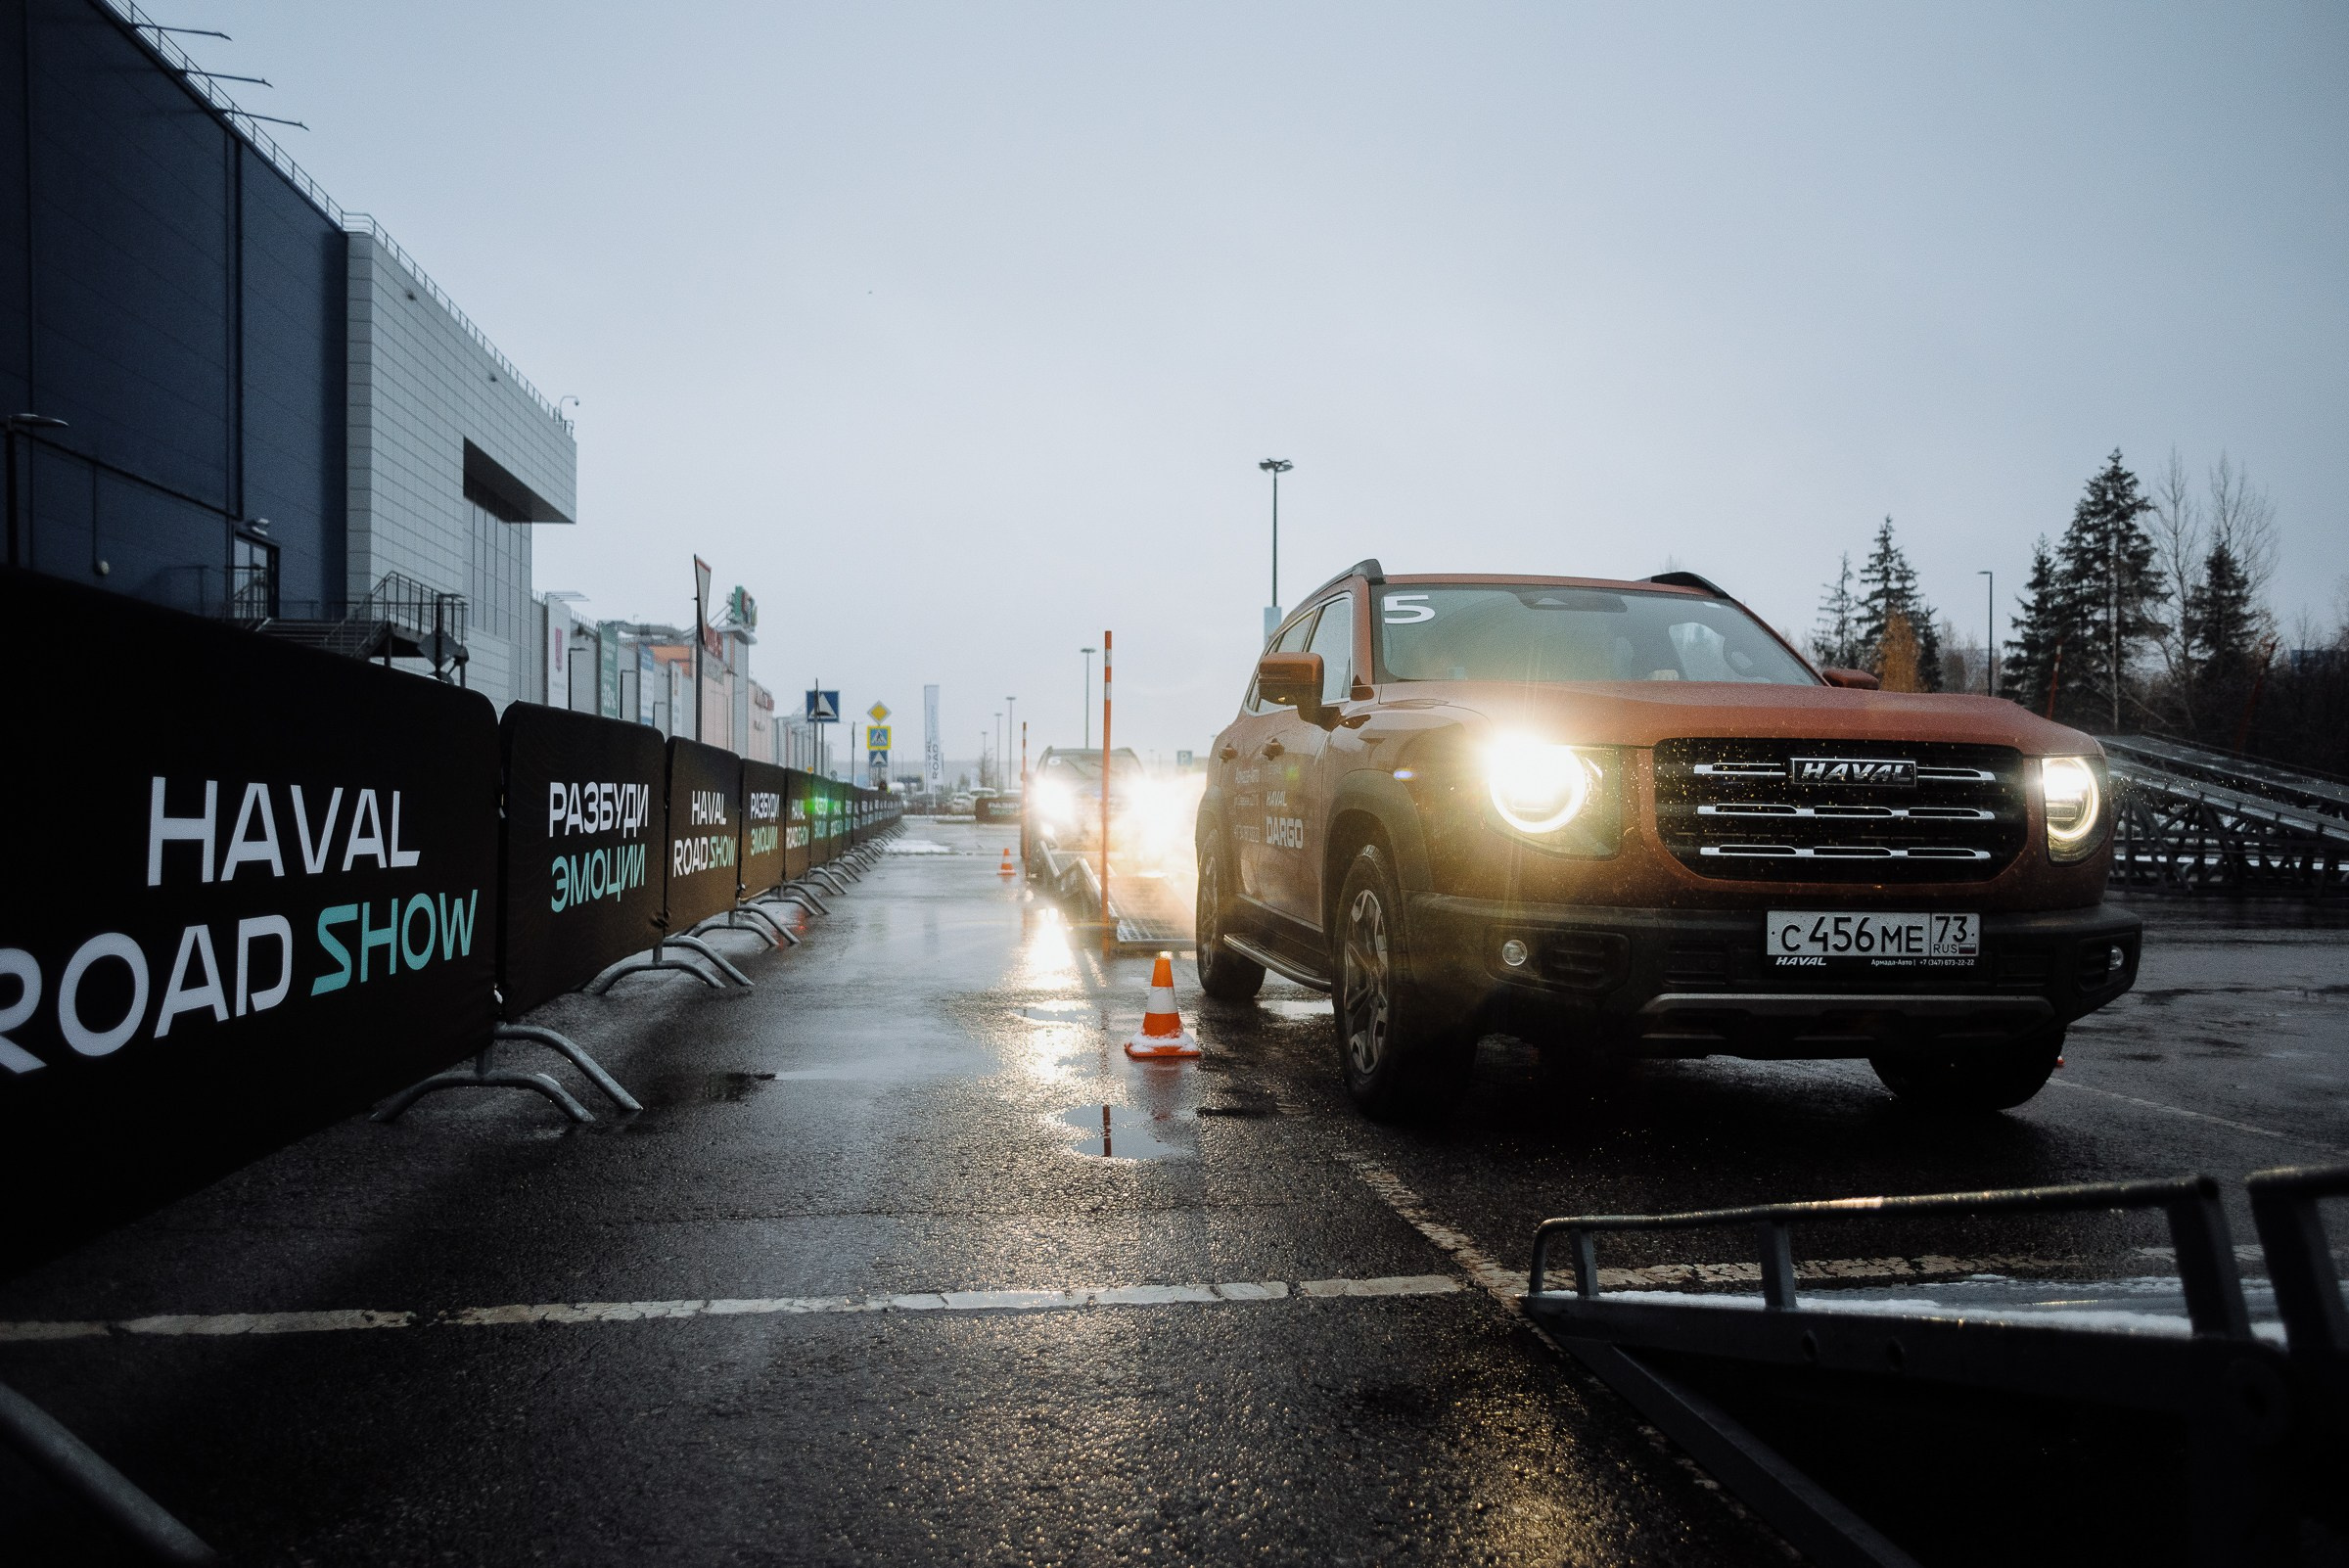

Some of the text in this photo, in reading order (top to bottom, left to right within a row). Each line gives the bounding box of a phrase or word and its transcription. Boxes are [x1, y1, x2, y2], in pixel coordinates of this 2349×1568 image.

[1383, 594, 1436, 624] 5
[1802, 762, 1911, 782] HAVAL
[549, 782, 649, 839] РАЗБУДИ
[692, 790, 726, 826] HAVAL
[750, 792, 780, 823] РАЗБУДИ
[1266, 790, 1287, 807] HAVAL
[147, 776, 421, 887] HAVAL
[751, 825, 778, 856] ЭМОЦИИ
[1266, 815, 1304, 849] DARGO
[673, 835, 737, 878] ROAD SHOW
[551, 844, 646, 912] ЭМОЦИИ
[310, 889, 479, 996] SHOW
[1934, 915, 1968, 944] 73
[1775, 956, 1827, 966] HAVAL
[1933, 944, 1958, 954] RUS
